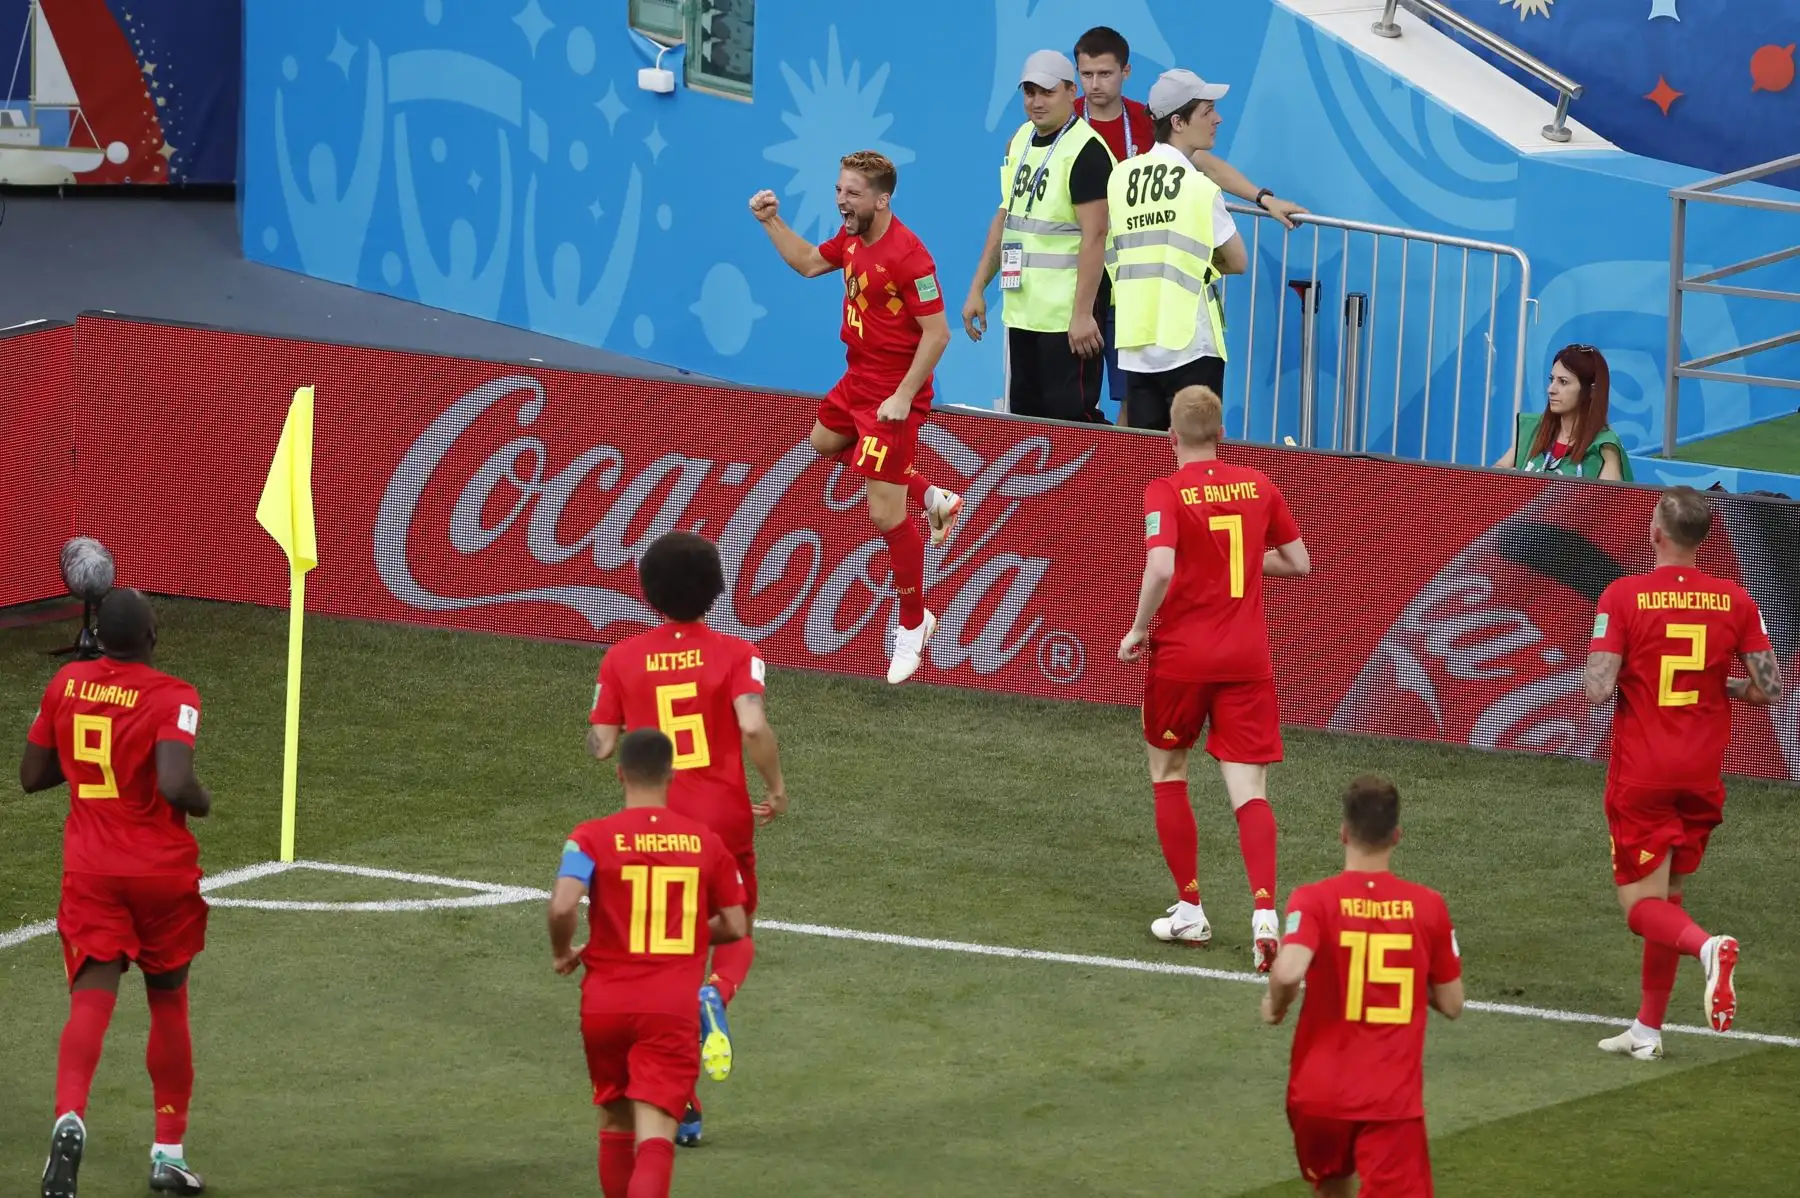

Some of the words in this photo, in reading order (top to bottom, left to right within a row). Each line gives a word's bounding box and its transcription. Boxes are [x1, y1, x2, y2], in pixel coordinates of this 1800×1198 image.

[1126, 164, 1186, 207] 8783
[846, 304, 864, 340] 14
[857, 435, 888, 473] 14
[1180, 487, 1202, 505] DE
[1203, 482, 1259, 503] BRUYNE
[373, 374, 1097, 676] Coca-Cola
[1208, 514, 1244, 599] 7
[1637, 591, 1731, 611] ALDERWEIRELD
[646, 649, 704, 672] WITSEL
[1658, 623, 1707, 707] 2
[64, 678, 76, 697] R.
[80, 681, 139, 708] LUKAKU
[656, 681, 711, 770] 6
[73, 713, 119, 799] 9
[614, 833, 632, 852] E.
[634, 833, 702, 853] HAZARD
[620, 864, 700, 955] 10
[1339, 898, 1414, 920] MEUNIER
[1339, 930, 1415, 1024] 15
